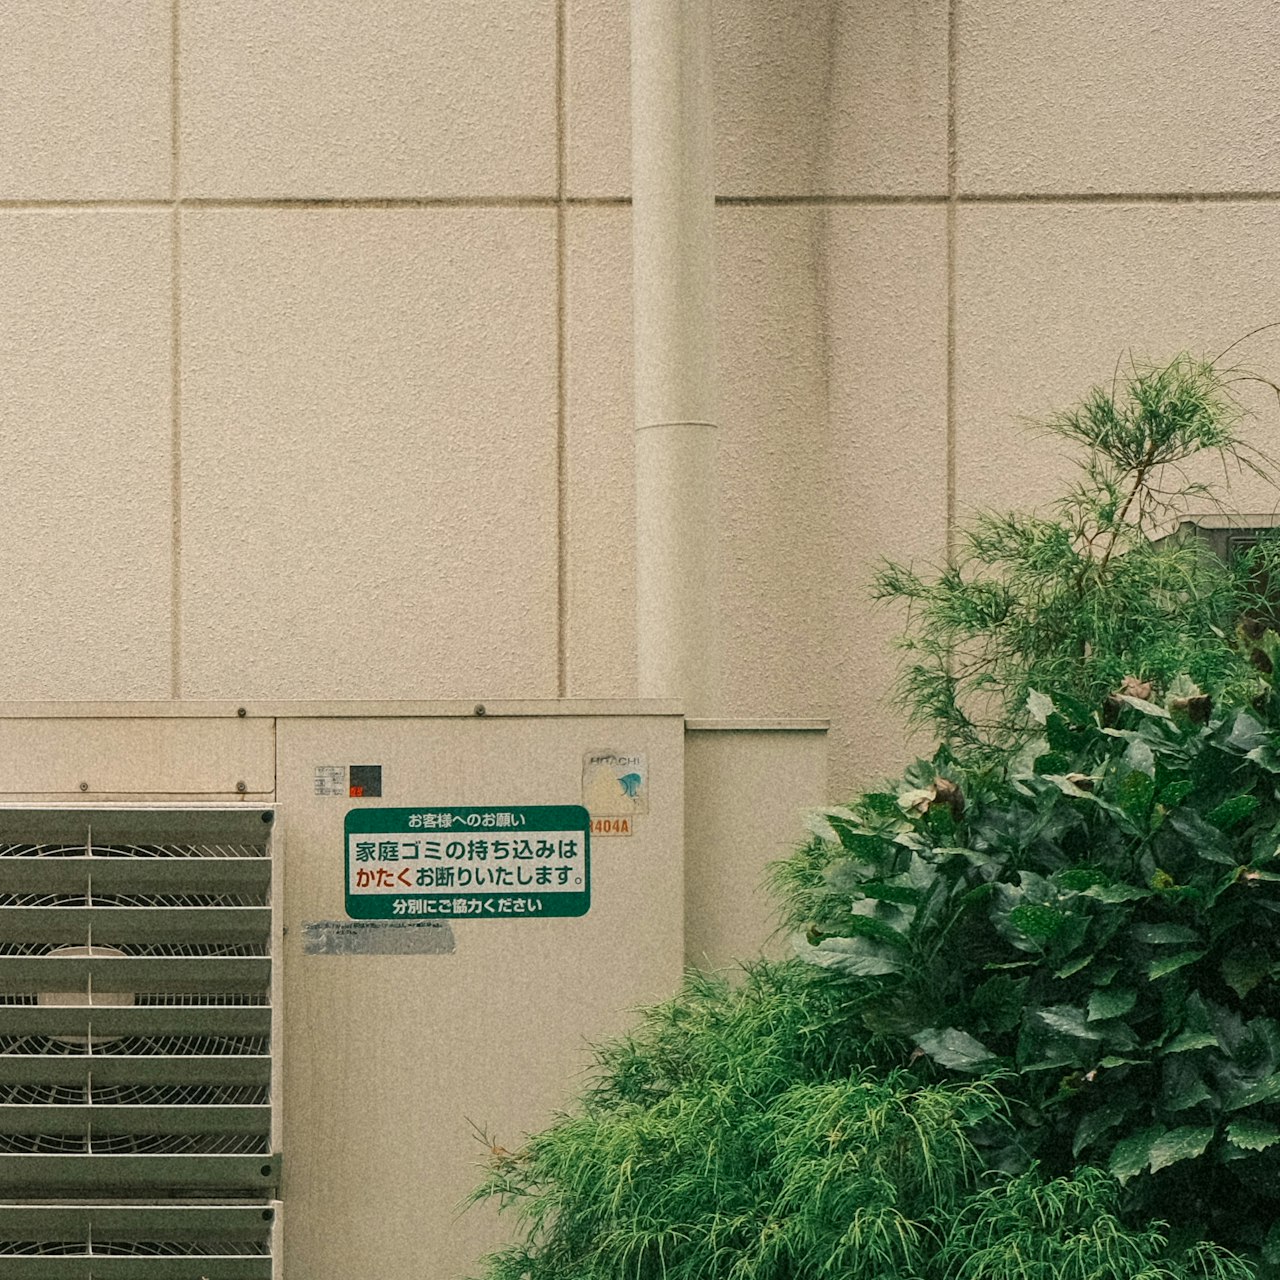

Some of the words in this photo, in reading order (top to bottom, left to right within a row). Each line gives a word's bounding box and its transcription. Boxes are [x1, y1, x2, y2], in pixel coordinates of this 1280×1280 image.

[408, 813, 526, 829] お客様へのお願い
[355, 839, 578, 863] 家庭ゴミの持ち込みは
[355, 865, 582, 888] かたくお断りいたします。
[392, 898, 543, 916] 分別にご協力ください
